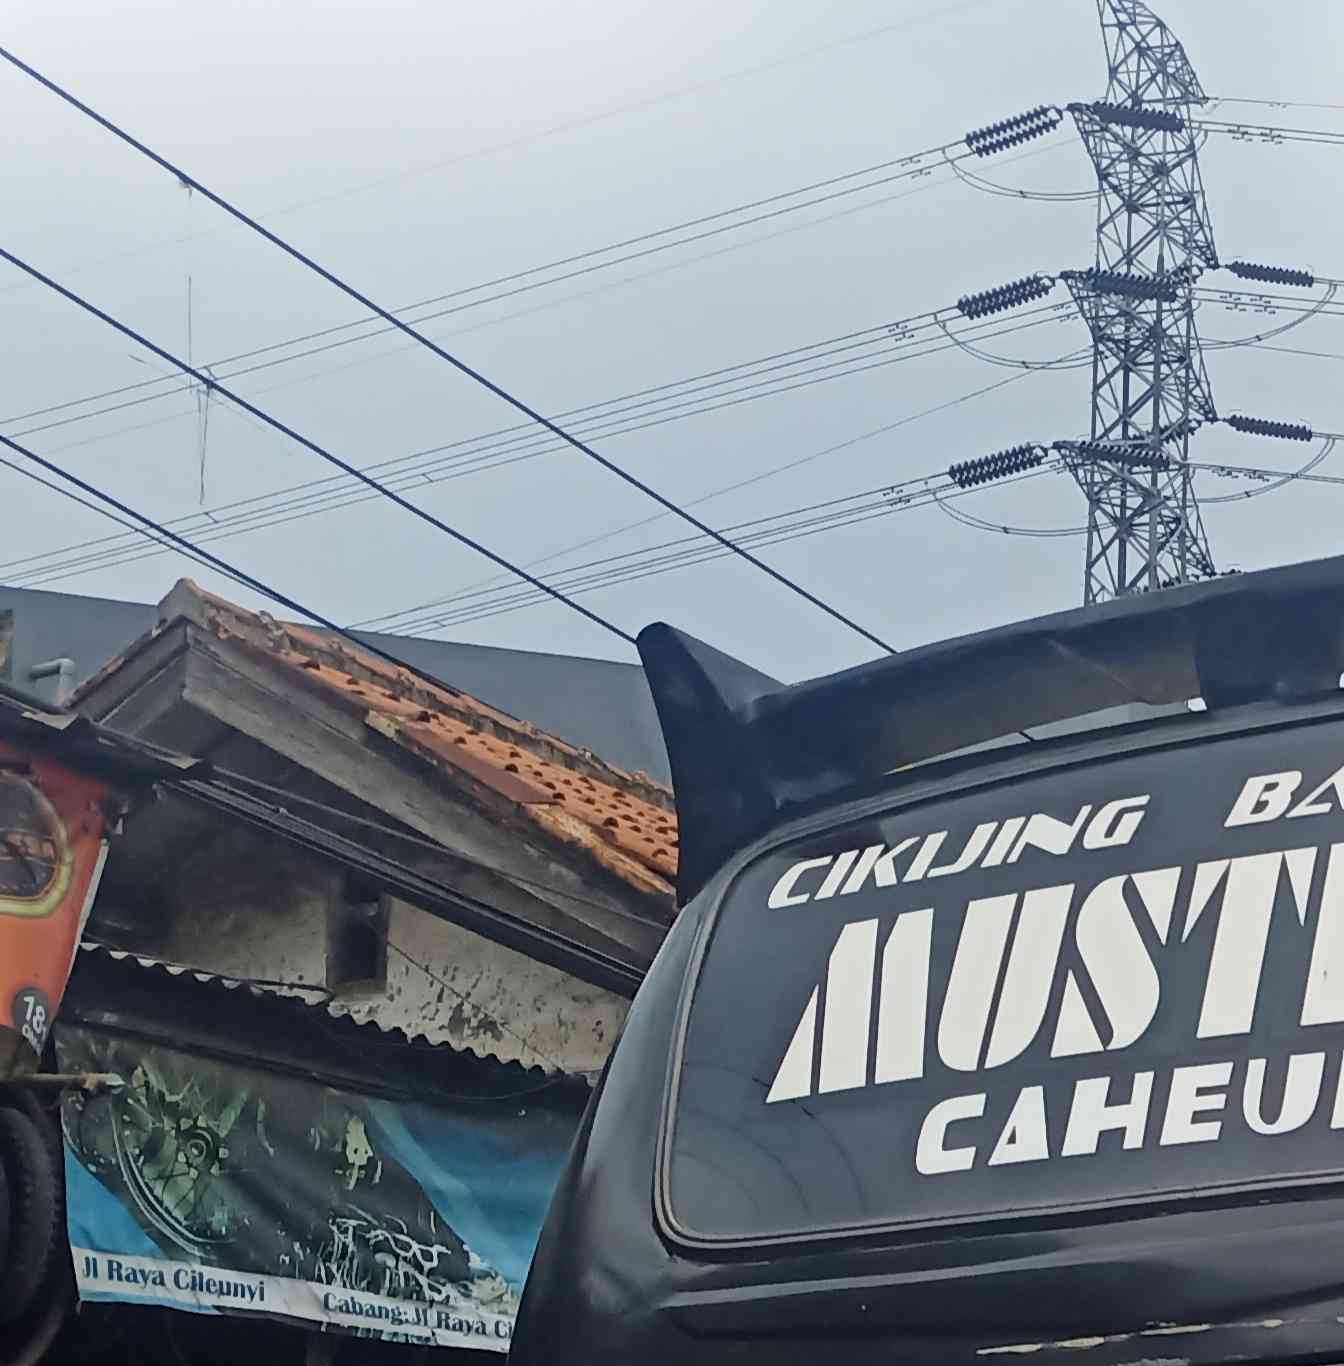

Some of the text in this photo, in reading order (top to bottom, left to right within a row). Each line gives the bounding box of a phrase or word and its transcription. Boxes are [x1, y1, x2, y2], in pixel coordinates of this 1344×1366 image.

[767, 794, 1151, 910] CIKIJING
[107, 1258, 165, 1289] Raya
[173, 1266, 265, 1303] Cileunyi
[437, 1311, 488, 1337] Raya
